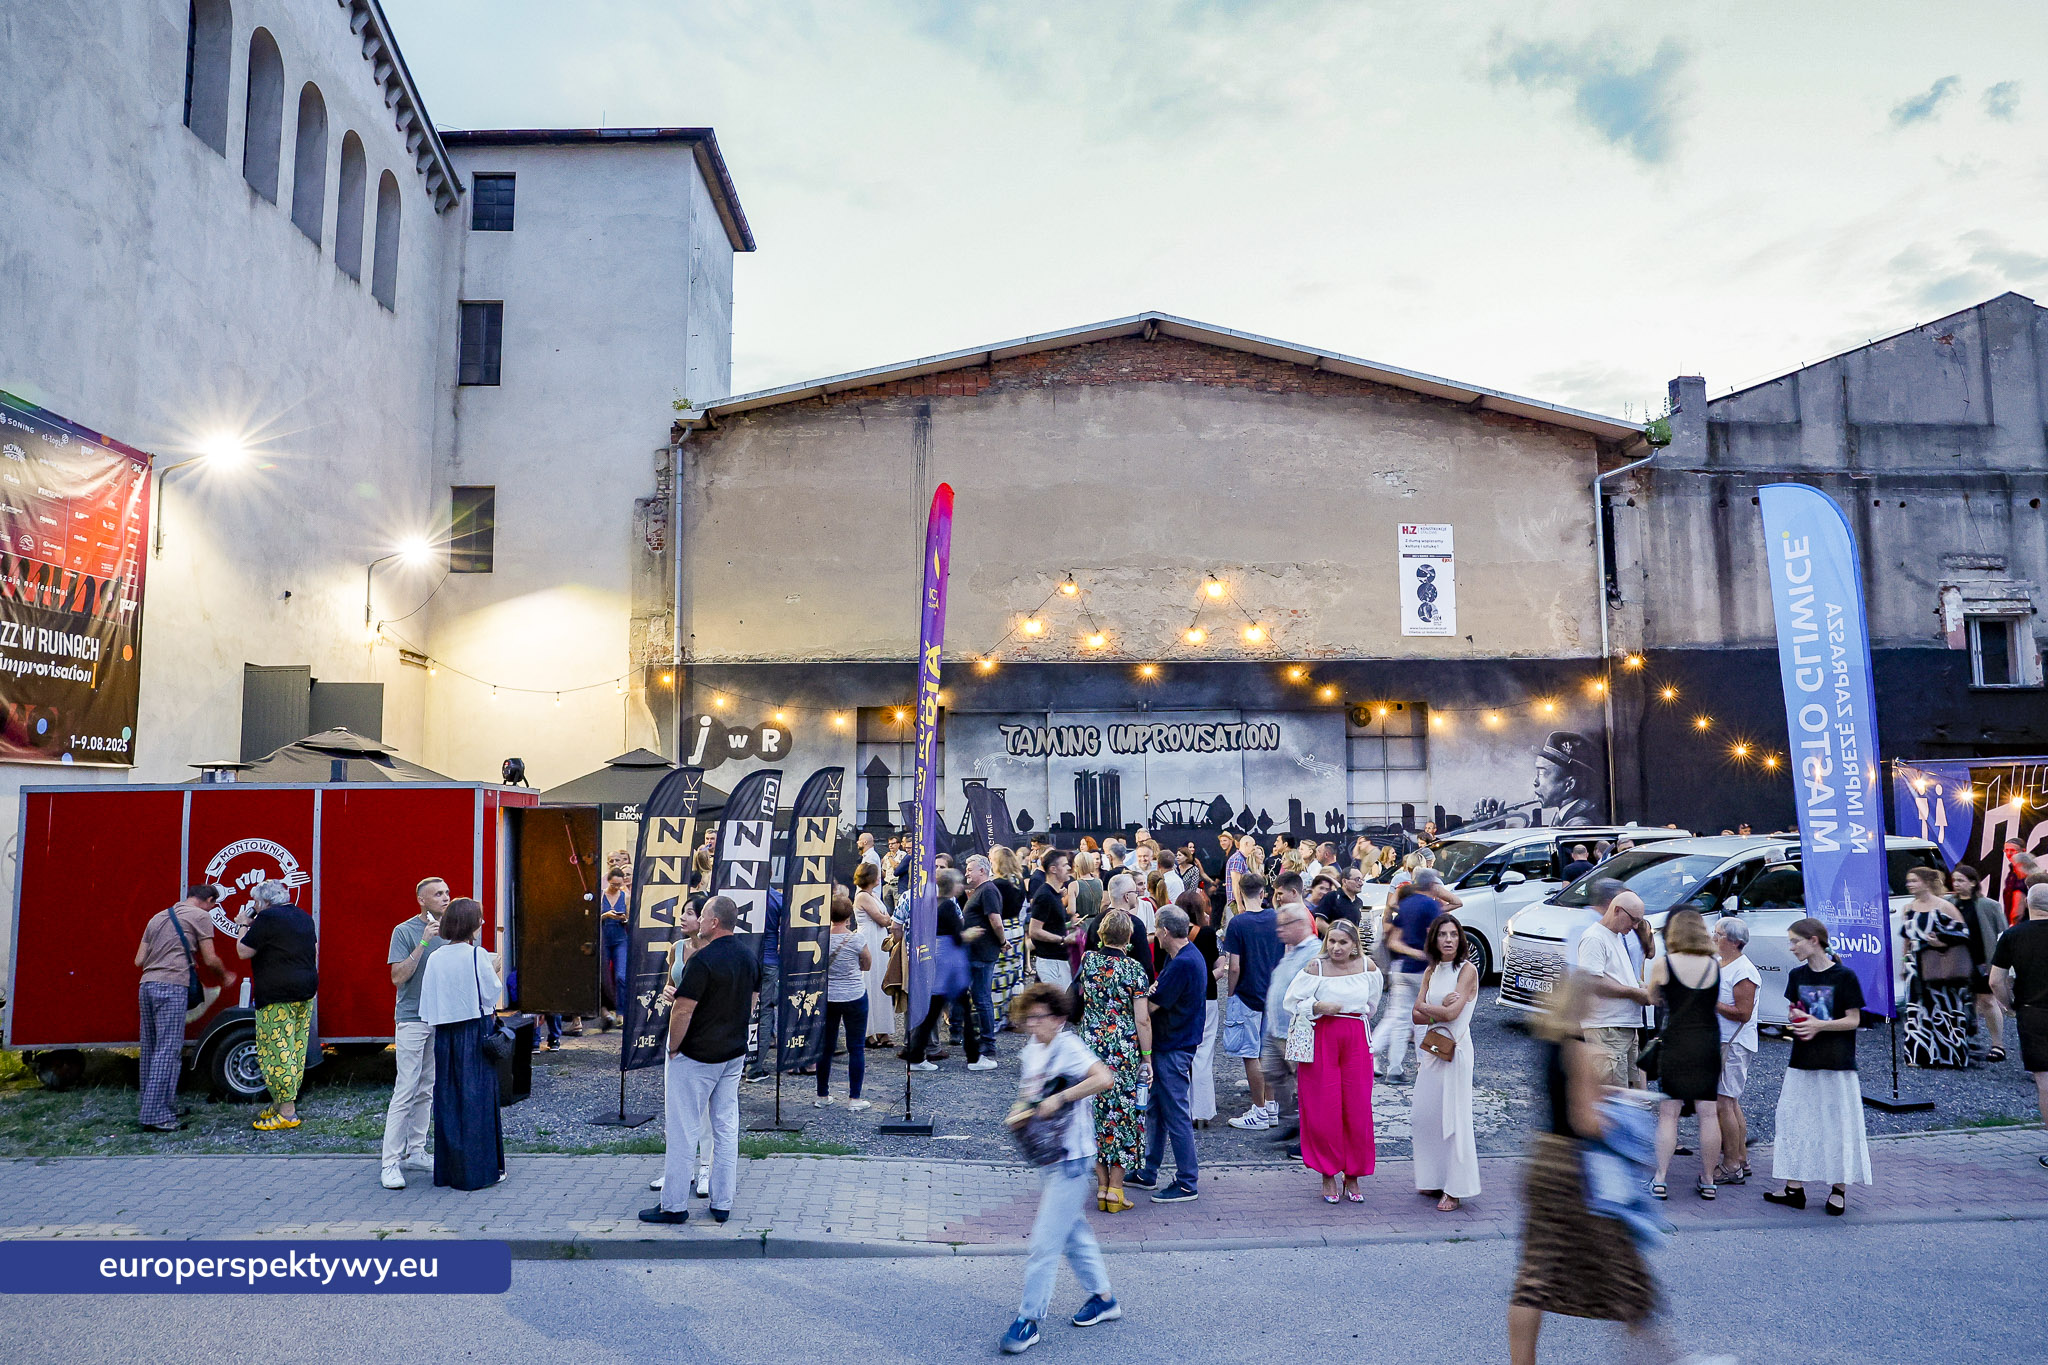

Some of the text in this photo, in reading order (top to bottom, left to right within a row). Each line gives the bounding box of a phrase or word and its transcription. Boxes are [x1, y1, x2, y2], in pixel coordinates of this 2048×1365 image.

[8, 417, 35, 434] SONING
[24, 580, 34, 588] na
[37, 582, 68, 597] festiwal
[0, 621, 100, 661] ZZ W RUINACH
[70, 734, 128, 753] 1-9.08.2025
[1000, 723, 1280, 757] TAMING IMPROVISATION
[683, 774, 702, 814] 4K
[615, 811, 643, 820] LEMON
[623, 804, 639, 813] ON
[220, 841, 285, 861] MONTOWNIA
[730, 777, 780, 933] AZZ HD
[797, 818, 829, 965] JAZZ
